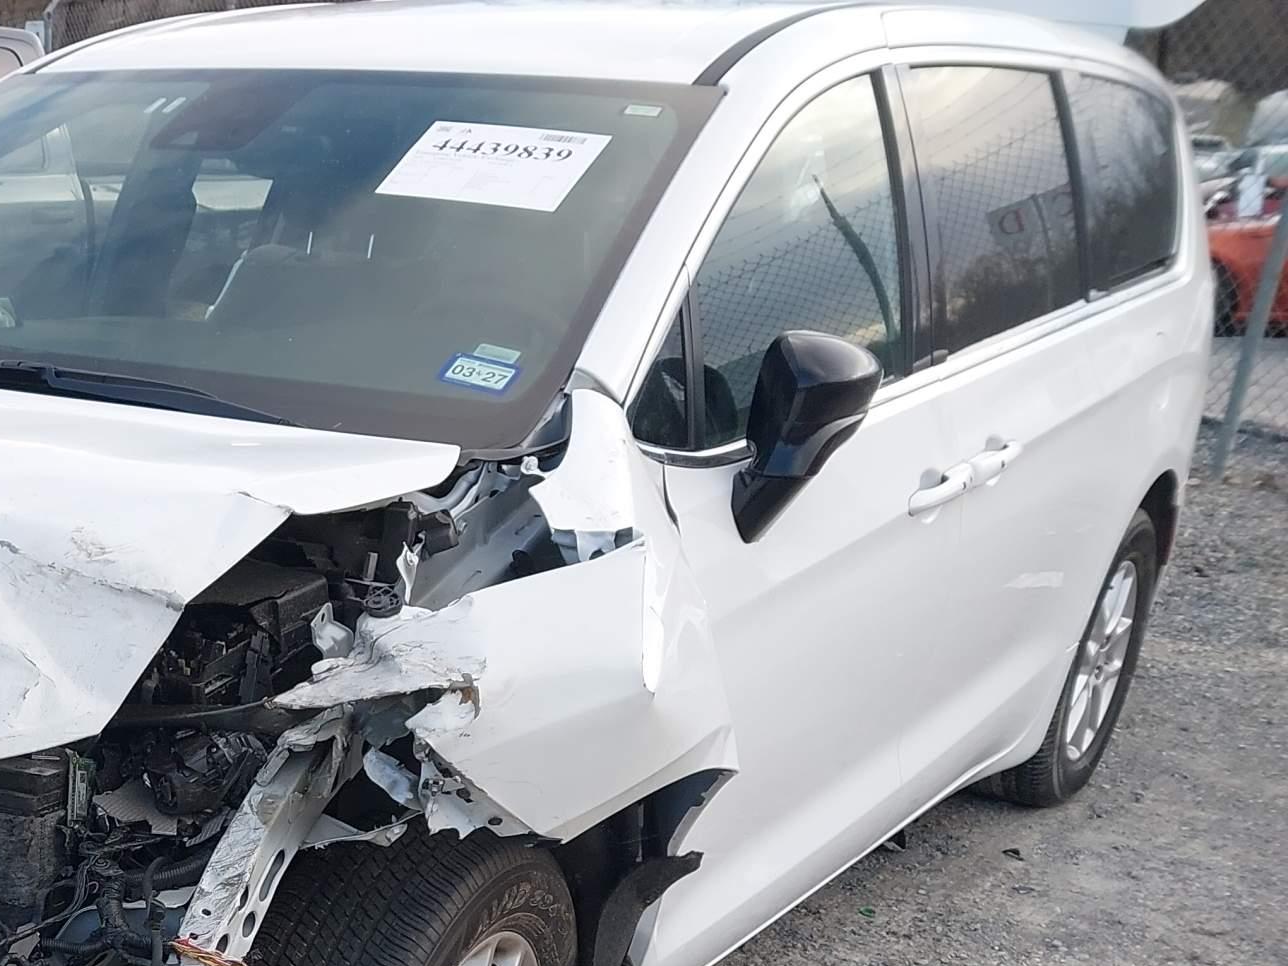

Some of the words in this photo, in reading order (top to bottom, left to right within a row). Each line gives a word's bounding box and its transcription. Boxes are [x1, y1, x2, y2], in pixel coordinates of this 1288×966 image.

[432, 138, 573, 162] 44439839
[451, 364, 476, 378] 03
[481, 371, 509, 385] 27
